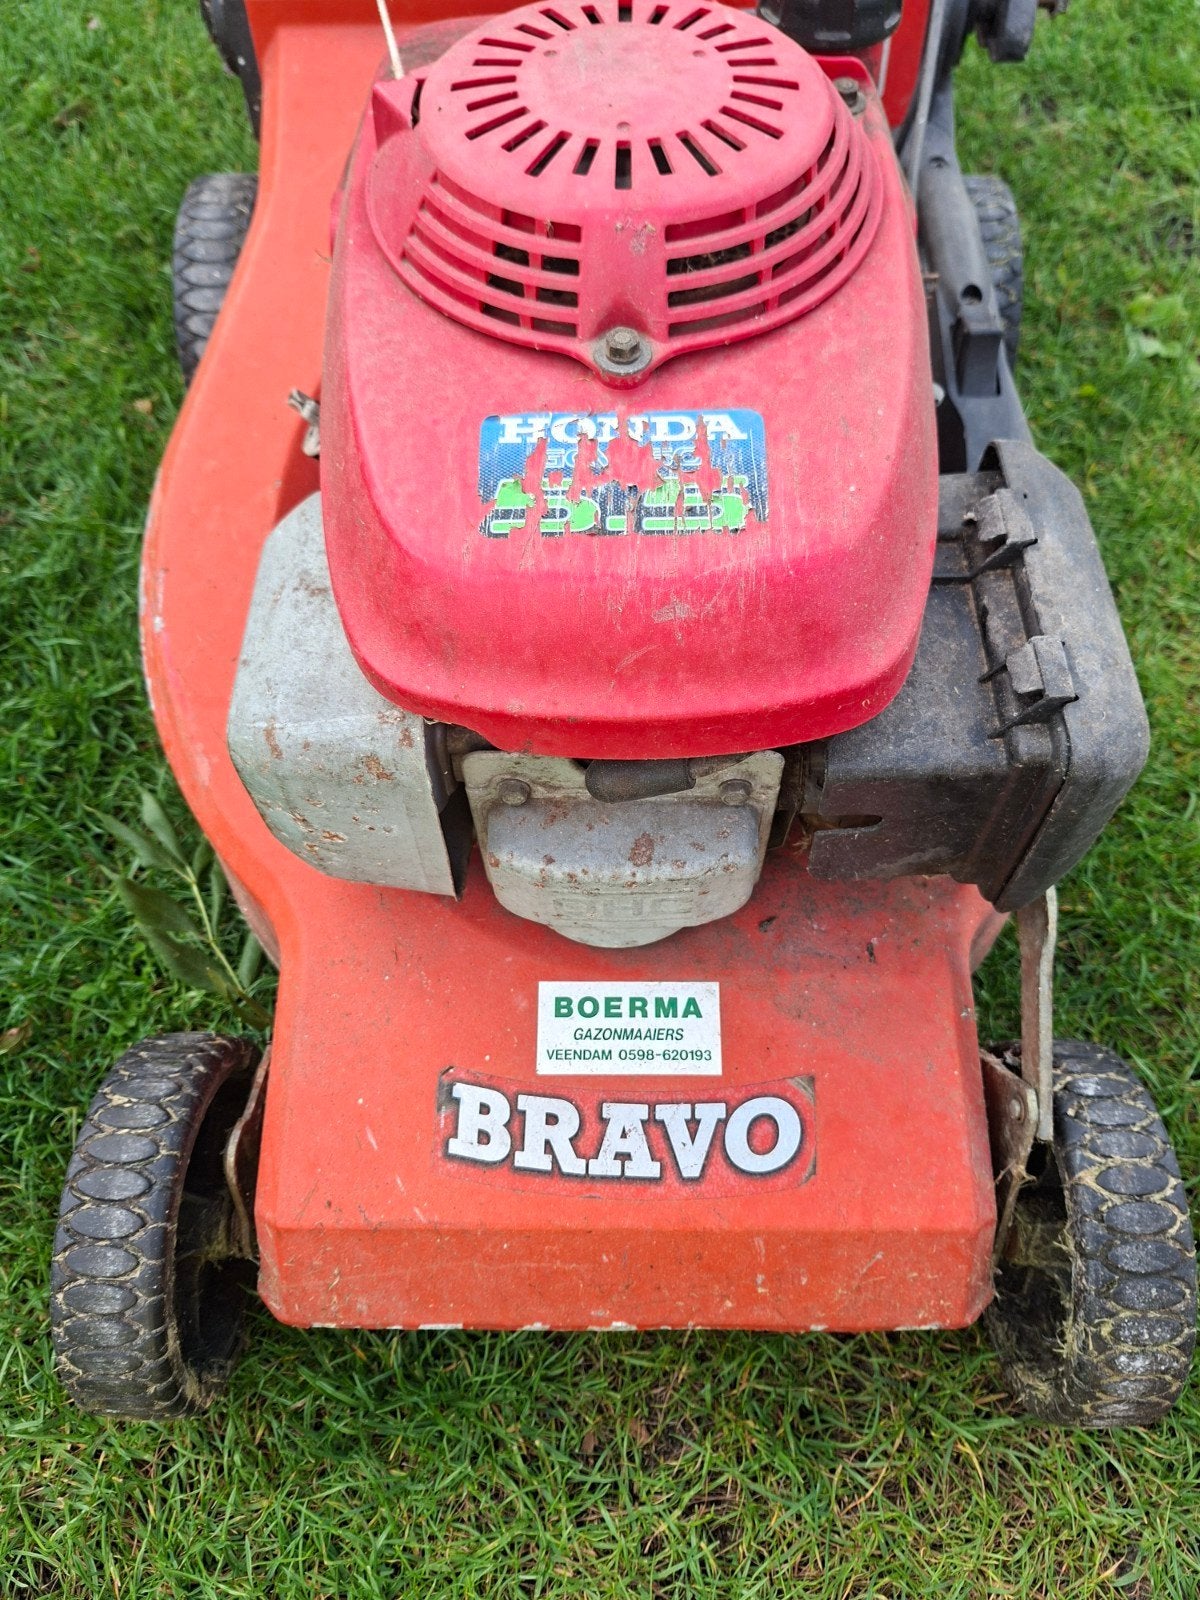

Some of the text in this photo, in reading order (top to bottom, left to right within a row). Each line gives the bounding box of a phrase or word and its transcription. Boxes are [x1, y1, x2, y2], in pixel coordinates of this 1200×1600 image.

[498, 413, 748, 444] HONDA
[554, 996, 703, 1019] BOERMA
[573, 1027, 684, 1041] GAZONMAAIERS
[546, 1049, 712, 1061] VEENDAM 0598-620193
[446, 1081, 804, 1180] BRAVO
